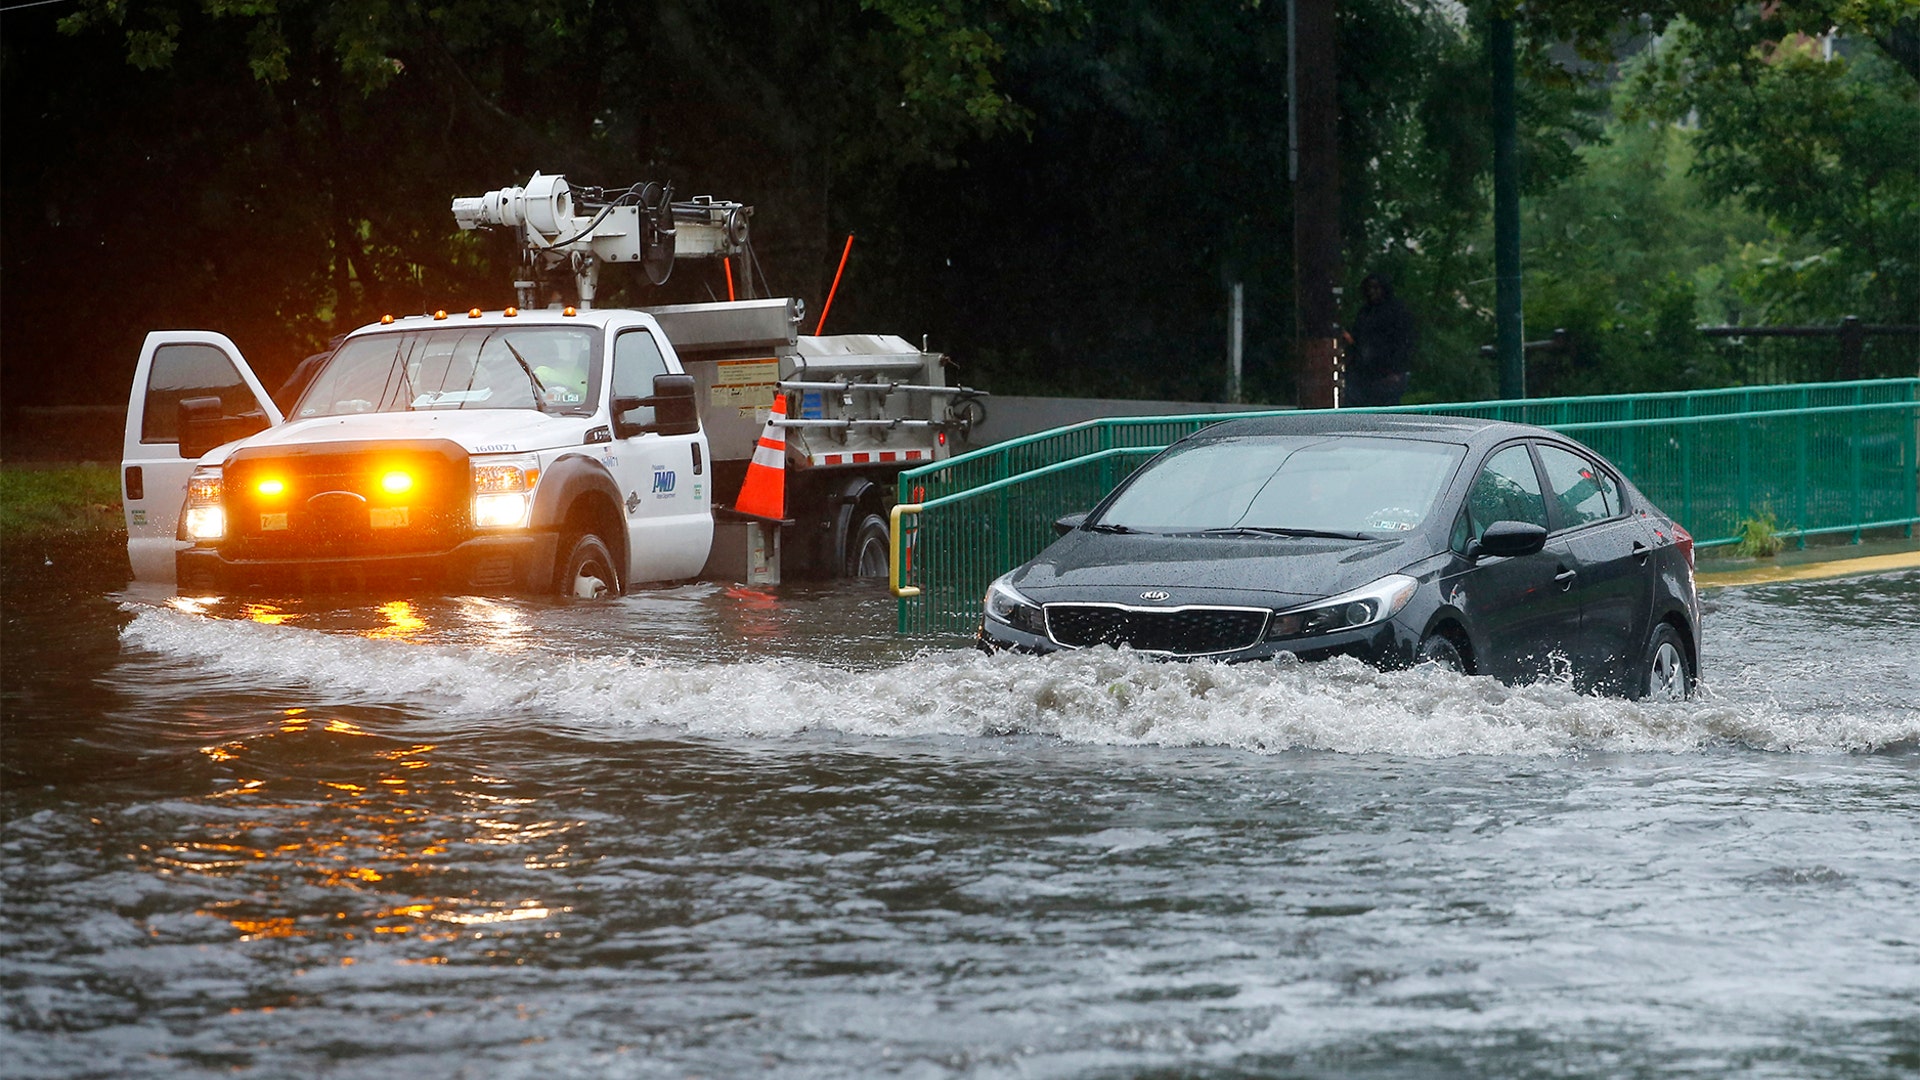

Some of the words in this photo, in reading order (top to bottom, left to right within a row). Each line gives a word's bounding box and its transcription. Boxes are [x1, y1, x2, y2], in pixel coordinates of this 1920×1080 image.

[473, 444, 517, 453] 160071
[652, 471, 676, 493] PWD
[1144, 591, 1164, 600] KIA
